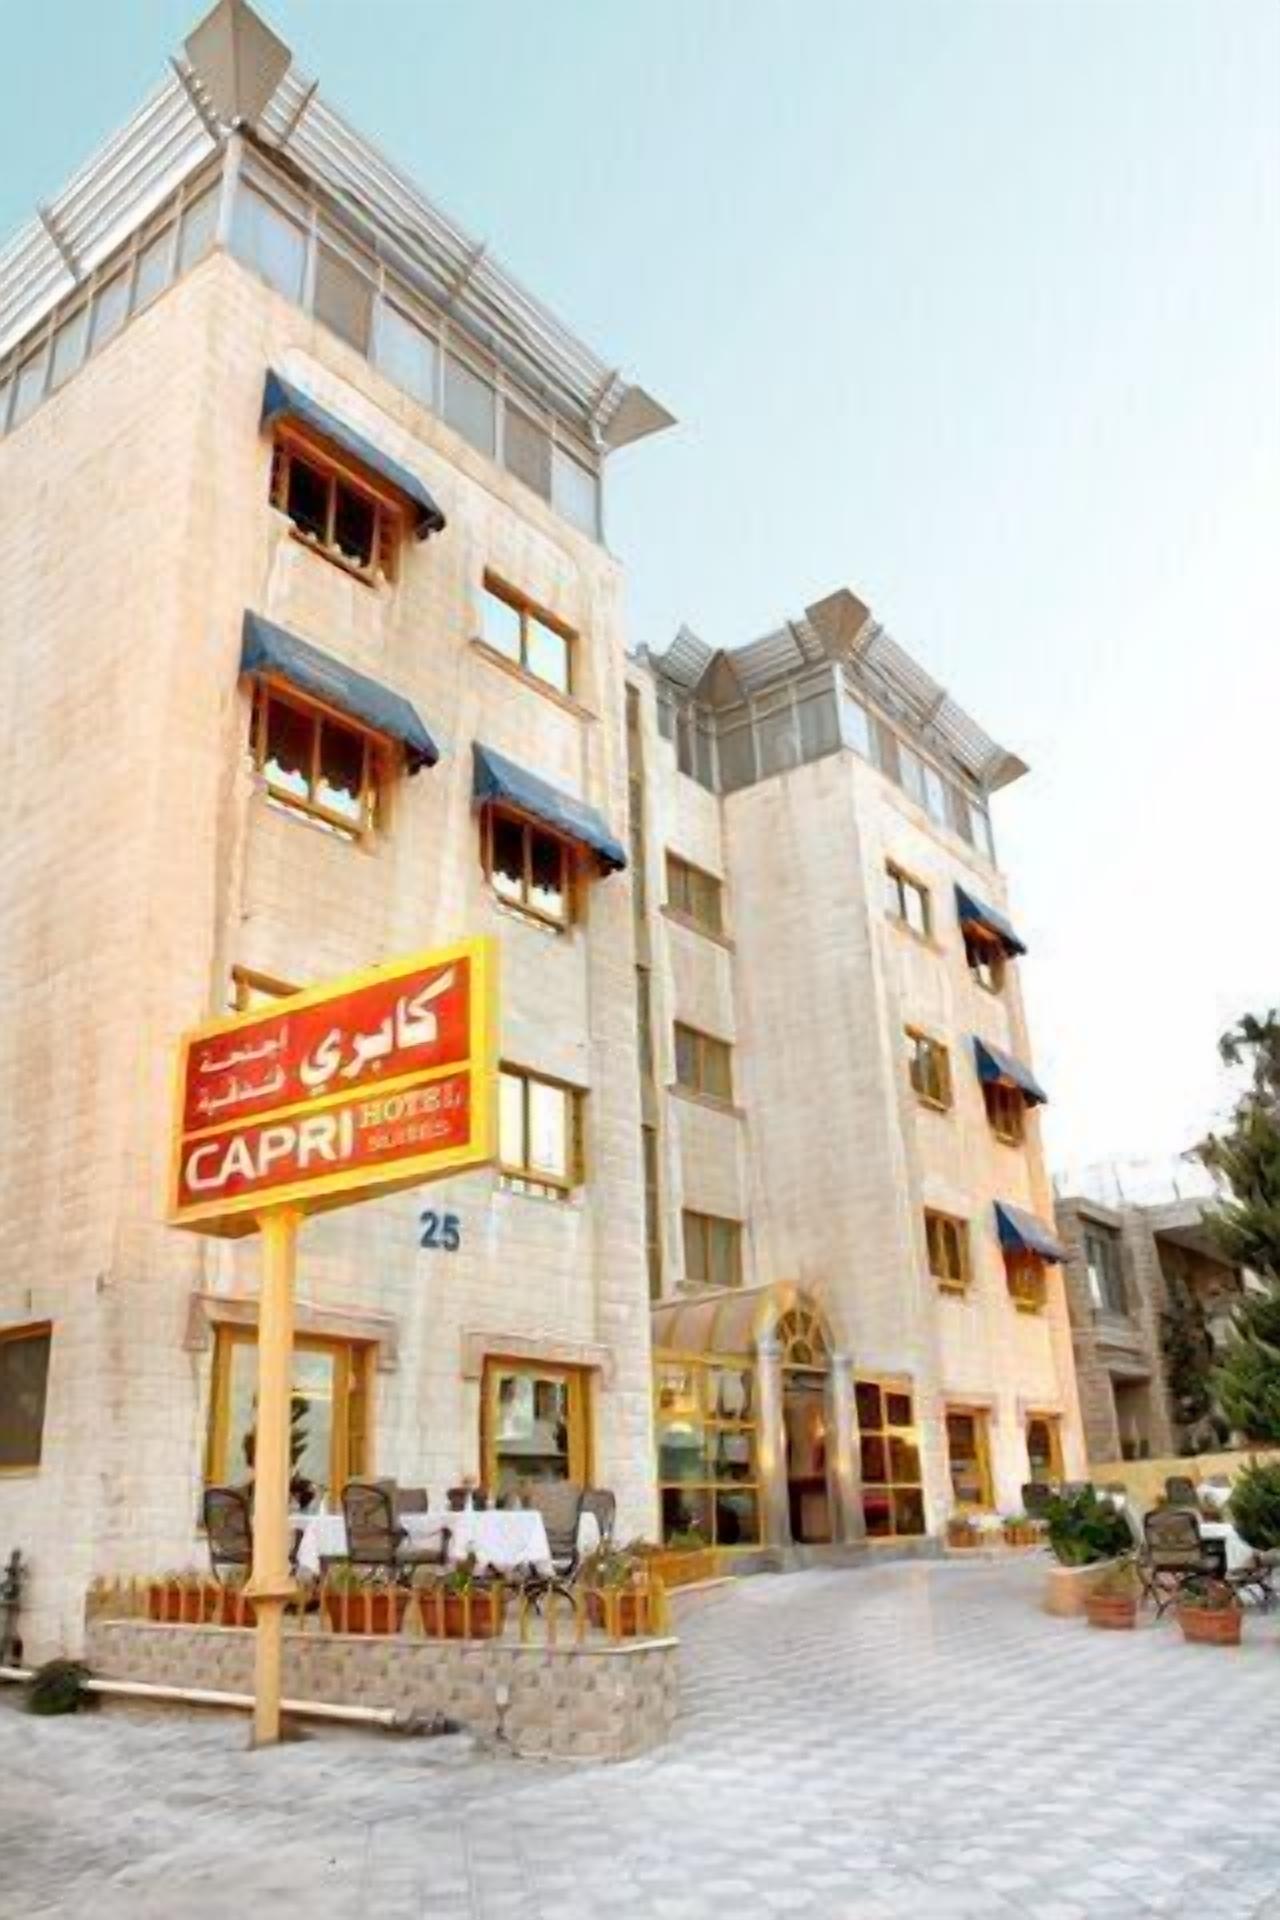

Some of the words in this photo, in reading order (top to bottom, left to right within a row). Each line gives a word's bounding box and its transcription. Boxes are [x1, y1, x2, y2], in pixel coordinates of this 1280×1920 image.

[301, 968, 455, 1095] كابري
[185, 1109, 354, 1191] CAPRI
[419, 1210, 461, 1251] 25
